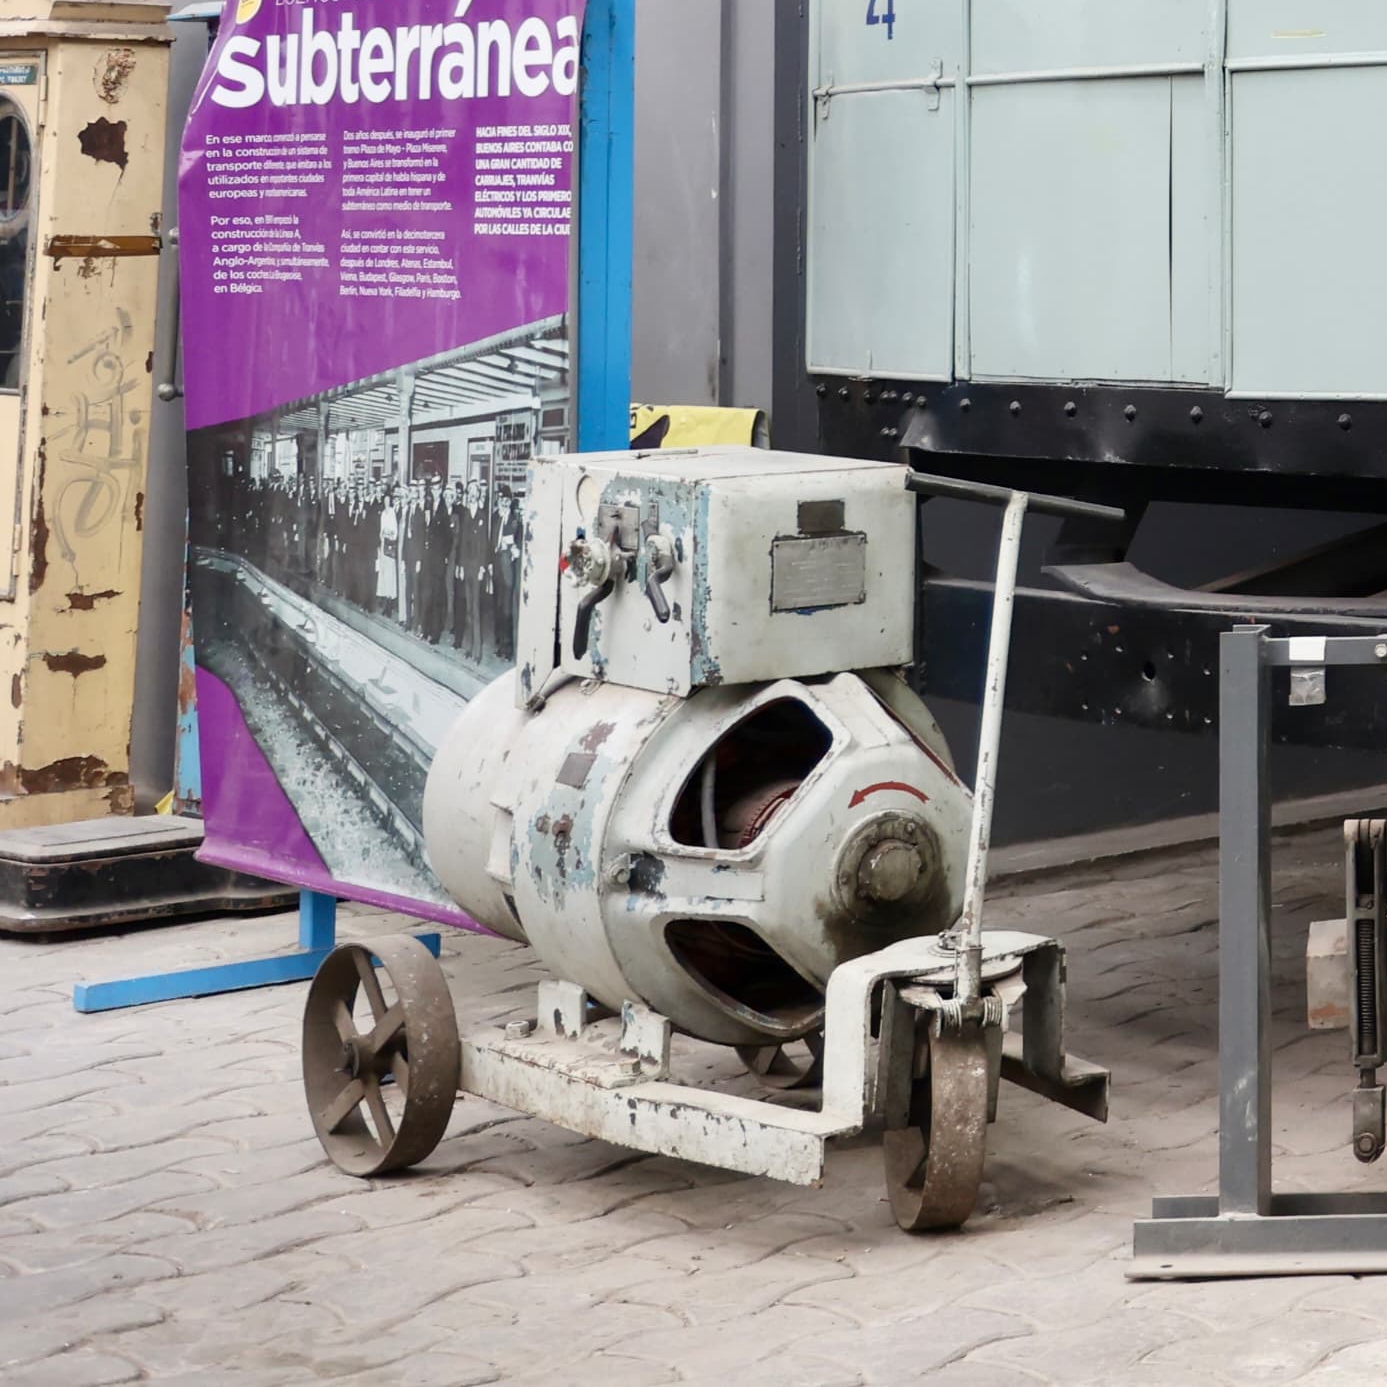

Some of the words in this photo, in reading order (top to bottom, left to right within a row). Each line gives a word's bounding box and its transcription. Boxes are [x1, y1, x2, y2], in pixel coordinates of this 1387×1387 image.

[476, 126, 496, 137] HACIA
[497, 126, 518, 137] FINES
[518, 125, 533, 137] DEL
[534, 125, 557, 136] SIGLO
[557, 124, 572, 138] XIX,
[206, 135, 220, 144] En
[223, 136, 242, 144] ese
[245, 135, 272, 143] marco
[206, 150, 219, 158] en
[223, 148, 233, 157] la
[476, 142, 502, 154] BUENOS
[503, 142, 524, 153] AIRES
[525, 141, 561, 153] CONTABA
[207, 162, 262, 172] transporte
[475, 158, 490, 170] UNA
[490, 158, 510, 169] GRAN
[511, 158, 550, 169] CANTIDAD
[551, 158, 562, 169] DE
[208, 174, 259, 185] utilizados
[475, 174, 516, 187] CARRUAJES,
[516, 172, 555, 185] TRANVÍAS
[209, 189, 258, 199] europeas
[475, 189, 515, 202] ELÉCTRICOS
[522, 191, 537, 202] LOS
[474, 205, 522, 218] AUTOMÓVILES
[522, 207, 532, 218] YA
[211, 215, 230, 226] Por
[232, 216, 253, 226] eso,
[254, 216, 264, 224] en
[474, 223, 488, 235] POR
[489, 224, 502, 235] LAS
[502, 224, 529, 235] CALLES
[530, 224, 541, 235] DE
[543, 224, 553, 235] LA
[221, 244, 251, 253] cargo
[252, 242, 263, 252] de
[213, 270, 228, 280] de
[230, 270, 244, 279] los
[214, 284, 227, 293] en
